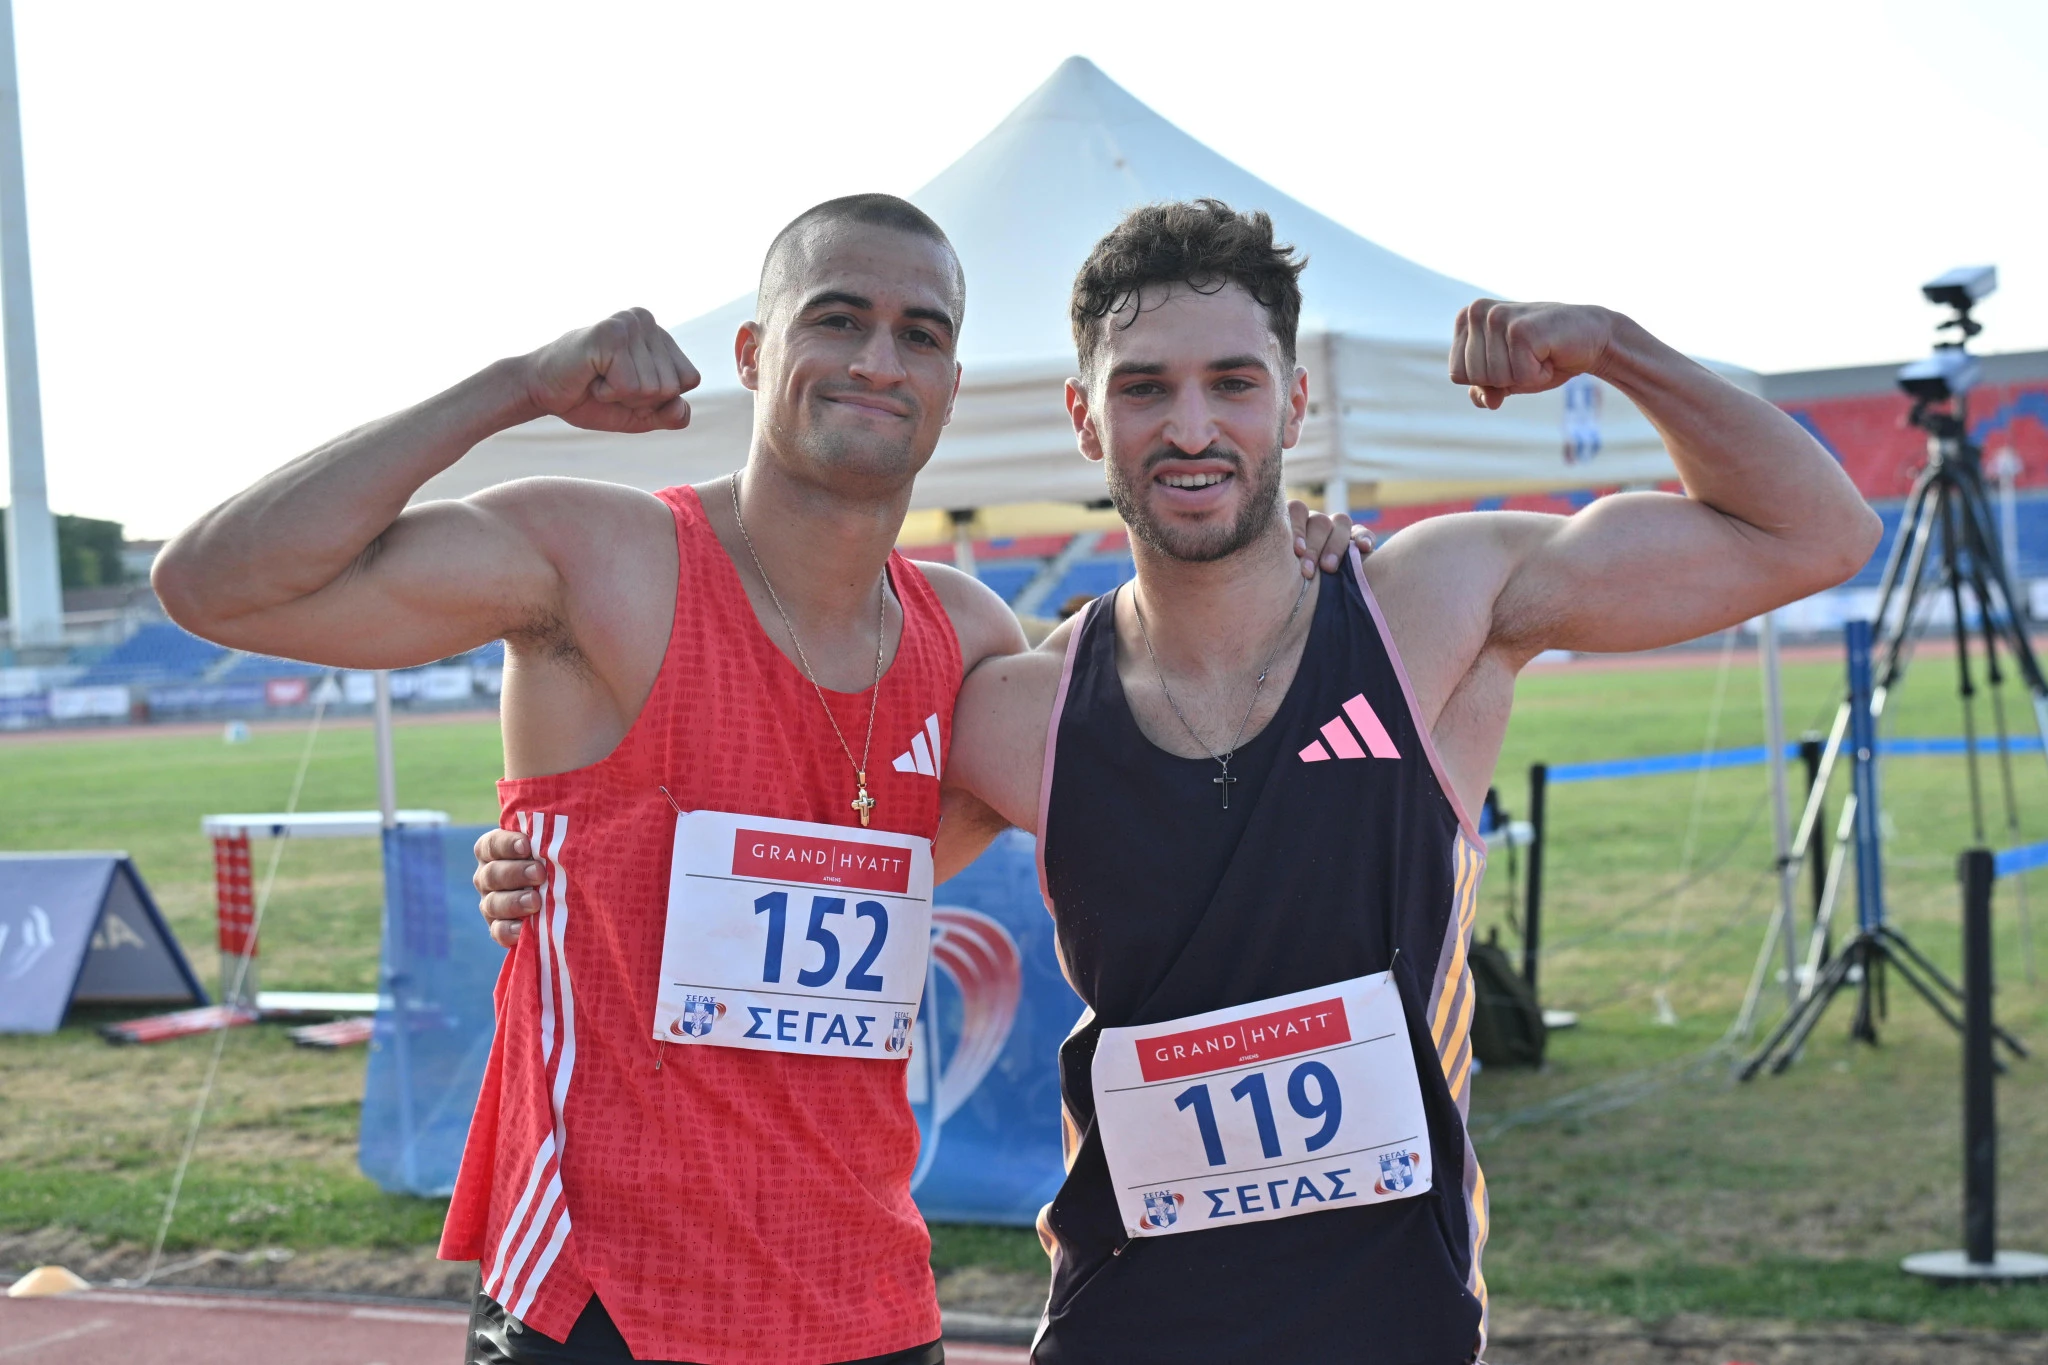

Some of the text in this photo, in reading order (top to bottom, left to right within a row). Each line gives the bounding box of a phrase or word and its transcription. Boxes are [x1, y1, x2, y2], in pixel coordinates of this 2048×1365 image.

[752, 843, 902, 874] GRAND HYATT
[753, 891, 889, 992] 152
[685, 994, 716, 1004] ΣΕΓΑΣ
[743, 1006, 876, 1048] ΣΕΓΑΣ
[1155, 1013, 1329, 1062] GRAND HYATT
[1173, 1060, 1343, 1167] 119
[1200, 1168, 1358, 1219] ΣΕΓΑΣ
